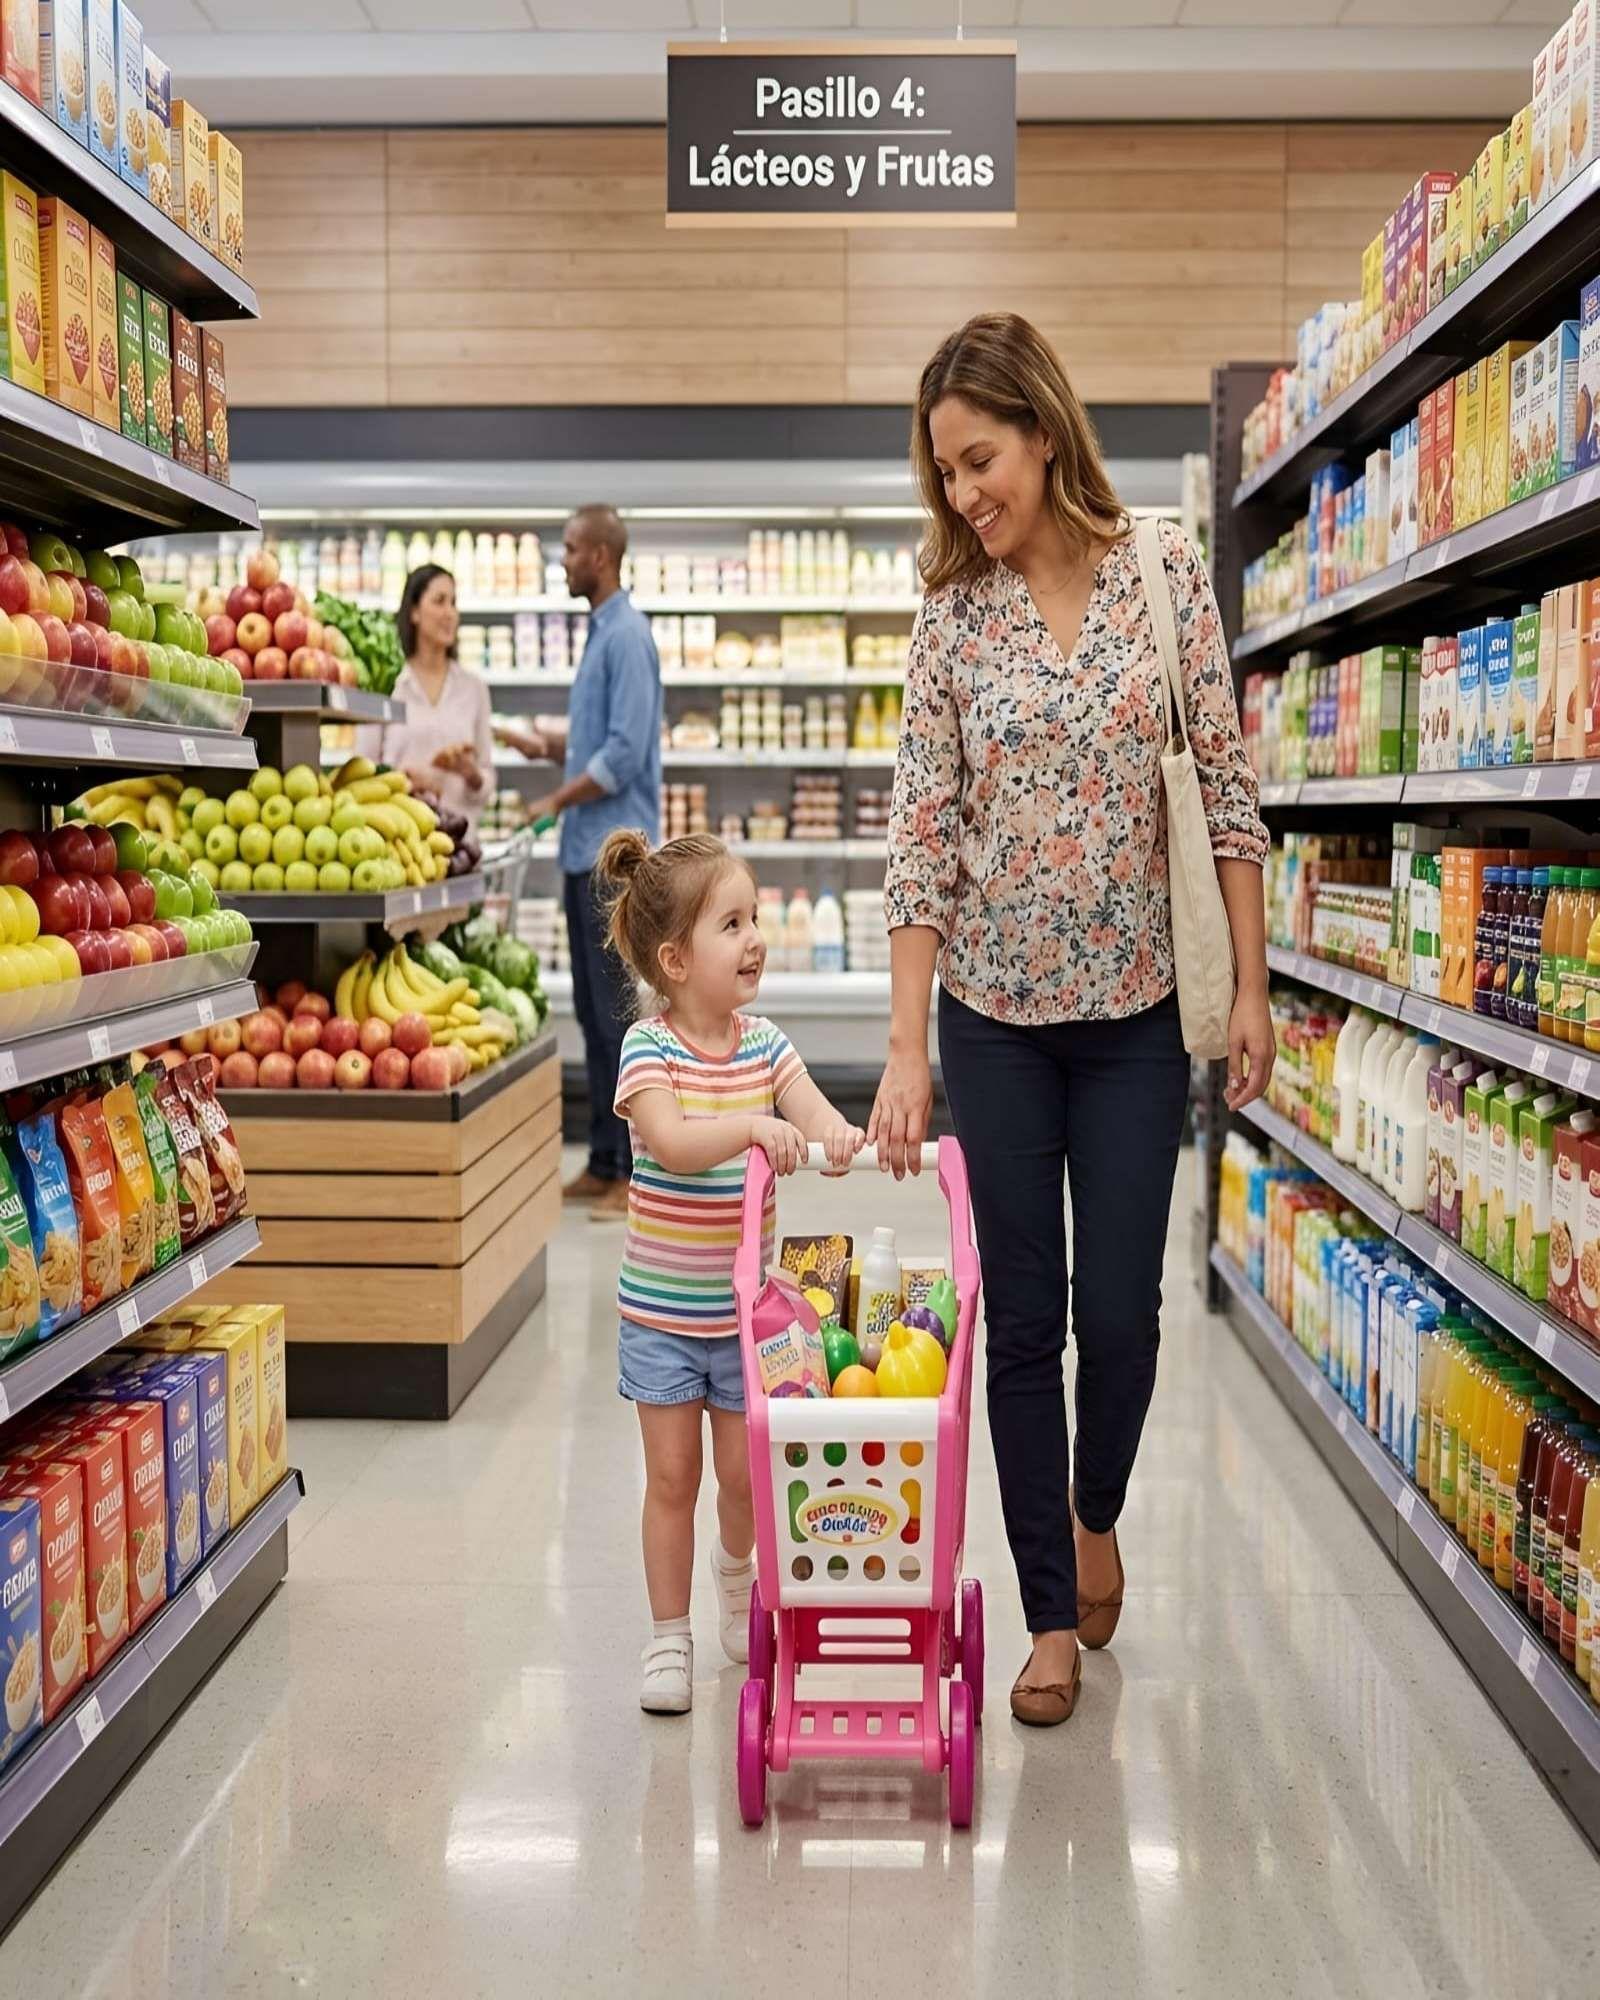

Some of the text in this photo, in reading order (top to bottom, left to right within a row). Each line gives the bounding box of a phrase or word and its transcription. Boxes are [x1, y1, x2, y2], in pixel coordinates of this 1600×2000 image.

[756, 76, 925, 118] Pasillo 4:
[689, 144, 995, 197] Lácteos y Frutas
